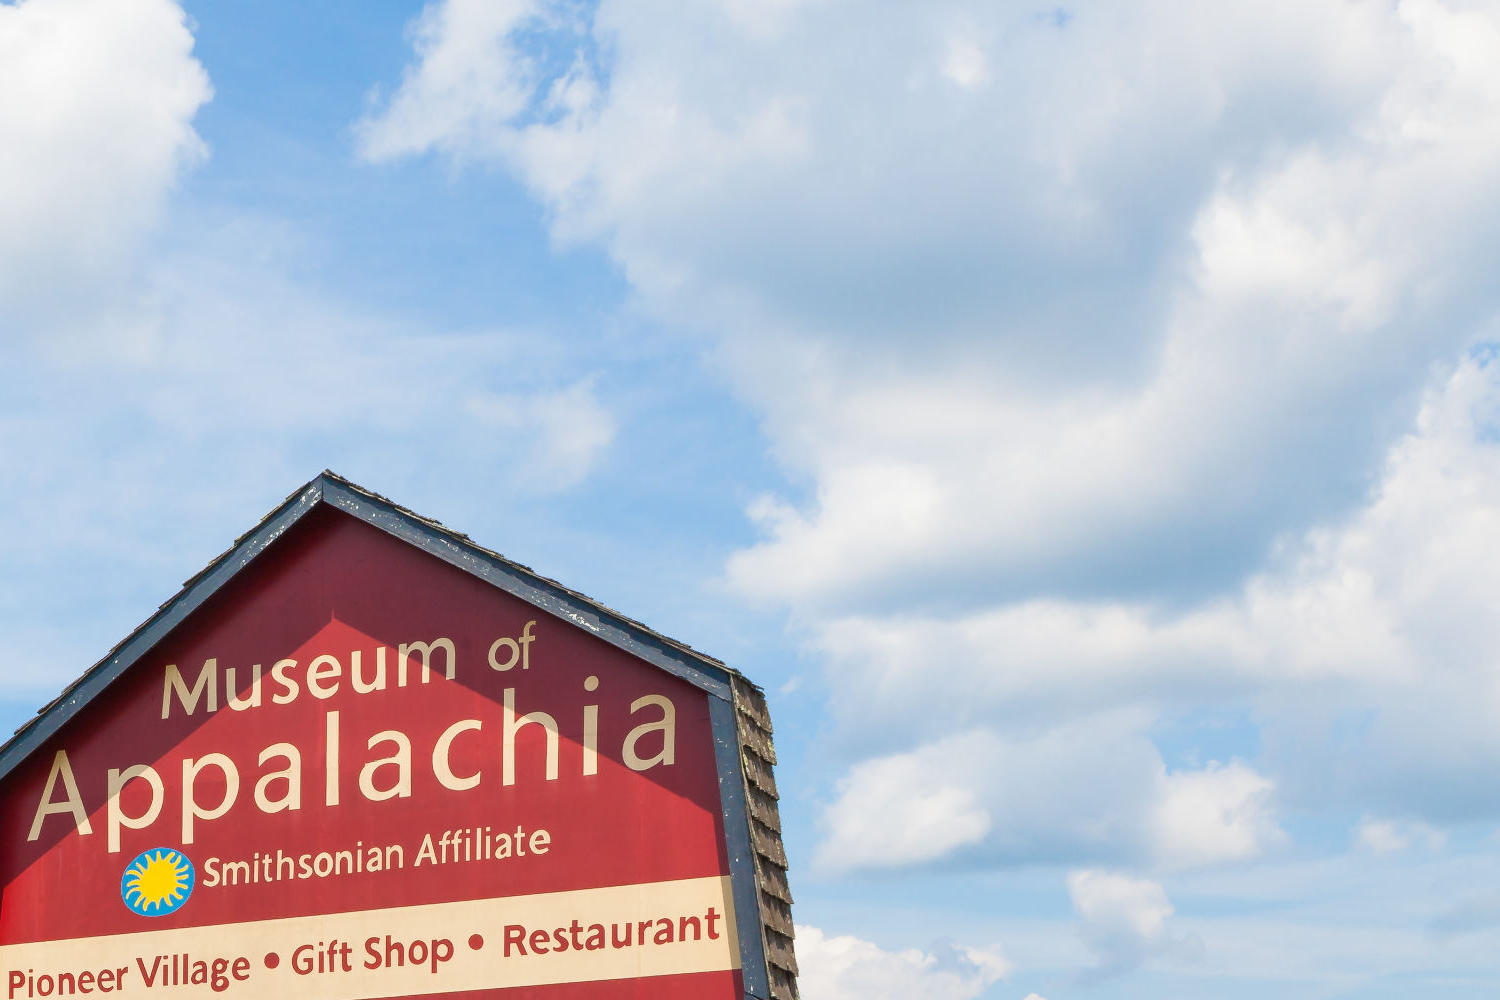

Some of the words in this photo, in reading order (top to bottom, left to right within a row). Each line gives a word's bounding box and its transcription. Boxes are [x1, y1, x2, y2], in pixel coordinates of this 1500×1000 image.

[162, 638, 455, 719] Museum
[488, 621, 536, 671] of
[26, 675, 676, 853] Appalachia
[203, 845, 403, 887] Smithsonian
[414, 825, 551, 867] Affiliate
[9, 967, 128, 999] Pioneer
[136, 954, 250, 992] Village
[292, 940, 352, 975] Gift
[364, 935, 454, 973] Shop
[504, 908, 720, 957] Restaurant
